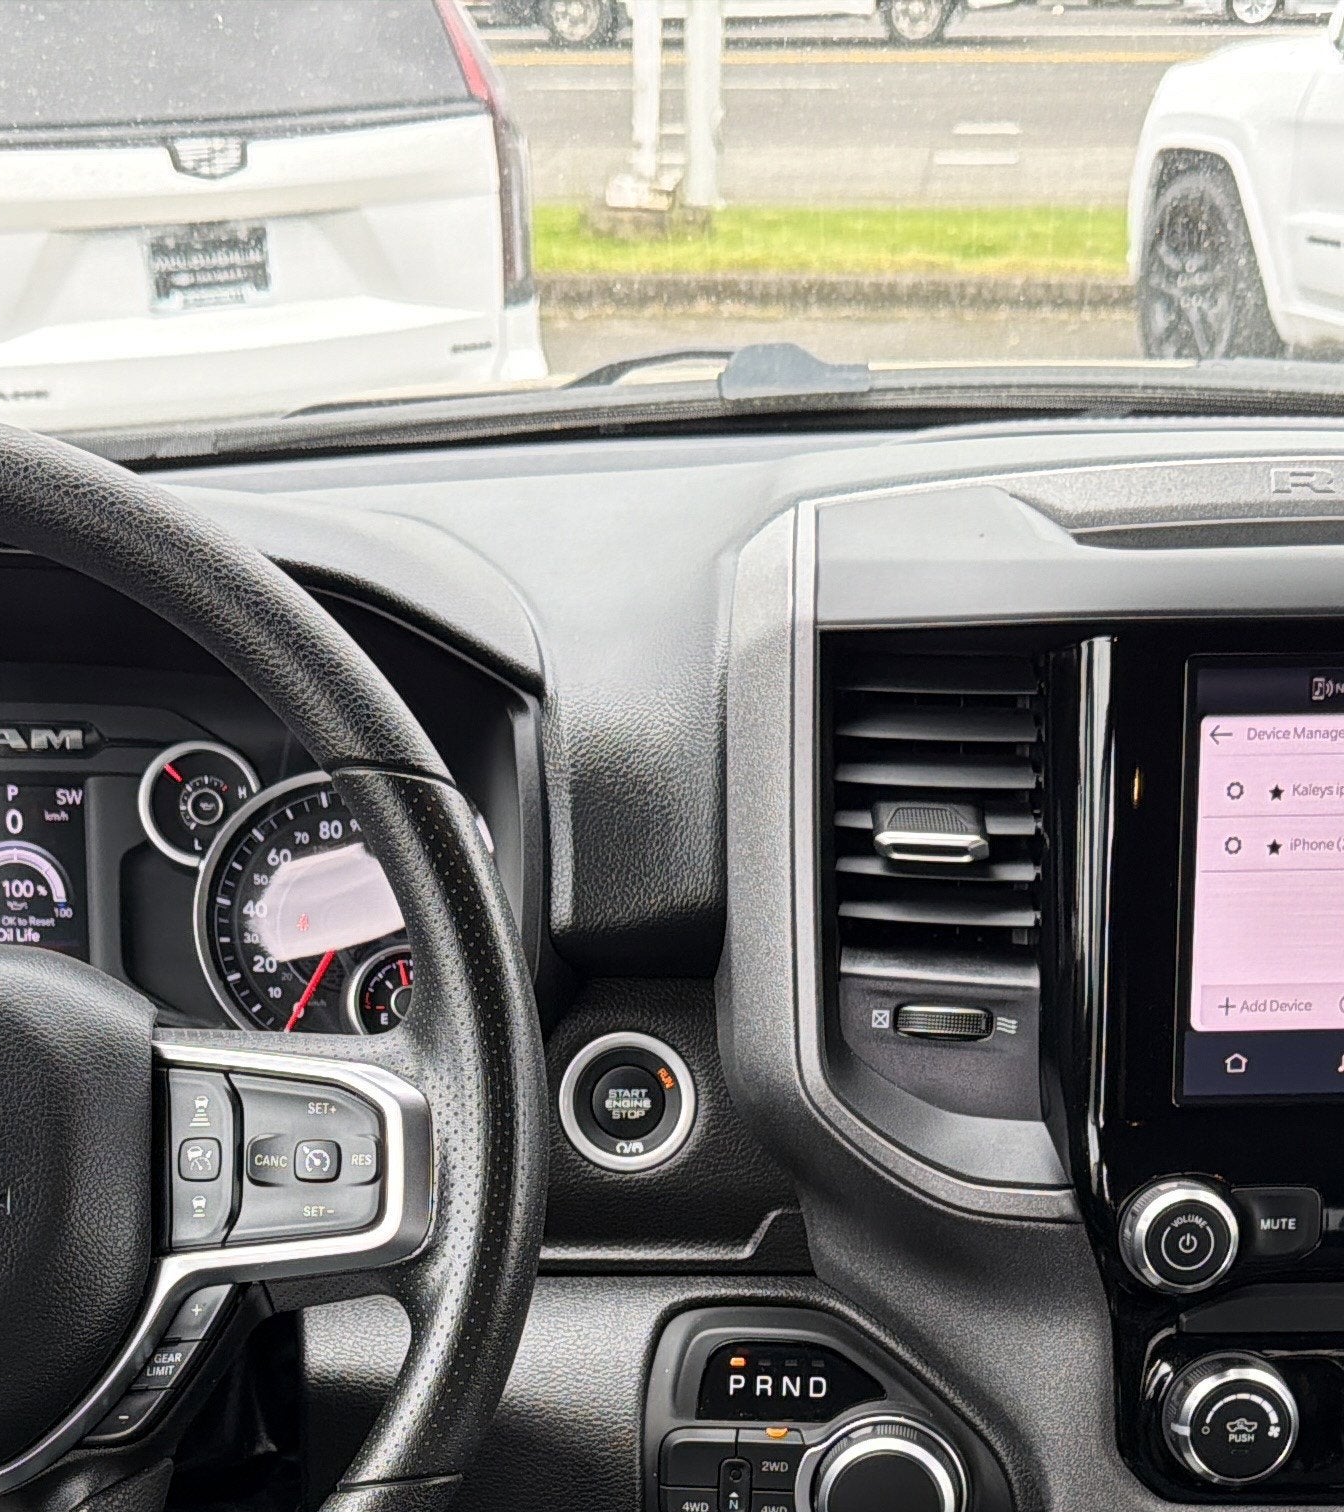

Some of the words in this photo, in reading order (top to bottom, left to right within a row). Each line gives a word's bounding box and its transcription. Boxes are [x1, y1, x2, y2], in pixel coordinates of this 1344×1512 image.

[1246, 726, 1291, 741] Device
[6, 784, 19, 802] P
[55, 787, 83, 806] SW
[1292, 783, 1334, 799] Kaleys
[5, 808, 24, 835] 0
[318, 819, 343, 840] 80
[293, 831, 310, 845] 70
[1289, 837, 1335, 852] iPhone
[267, 847, 292, 867] 60
[253, 872, 269, 886] 50
[1, 879, 35, 898] 100
[242, 900, 268, 919] 40
[16, 927, 41, 943] Life
[251, 954, 278, 974] 20
[267, 986, 282, 999] 10
[1239, 1000, 1267, 1013] Add
[1269, 998, 1313, 1013] Device
[379, 1012, 389, 1026] E
[608, 1088, 649, 1098] START
[604, 1098, 652, 1109] ENGINE
[611, 1109, 646, 1120] STOP
[254, 1153, 289, 1168] CANC
[350, 1153, 373, 1167] RES
[1170, 1213, 1209, 1229] VOLUME
[1260, 1217, 1297, 1231] MUTE
[153, 1352, 183, 1365] GEAR
[146, 1365, 176, 1377] LIMIT
[1228, 1433, 1255, 1443] PUSH
[761, 1460, 789, 1473] 2WD
[682, 1501, 709, 1512] 4WD
[728, 1499, 739, 1511] N
